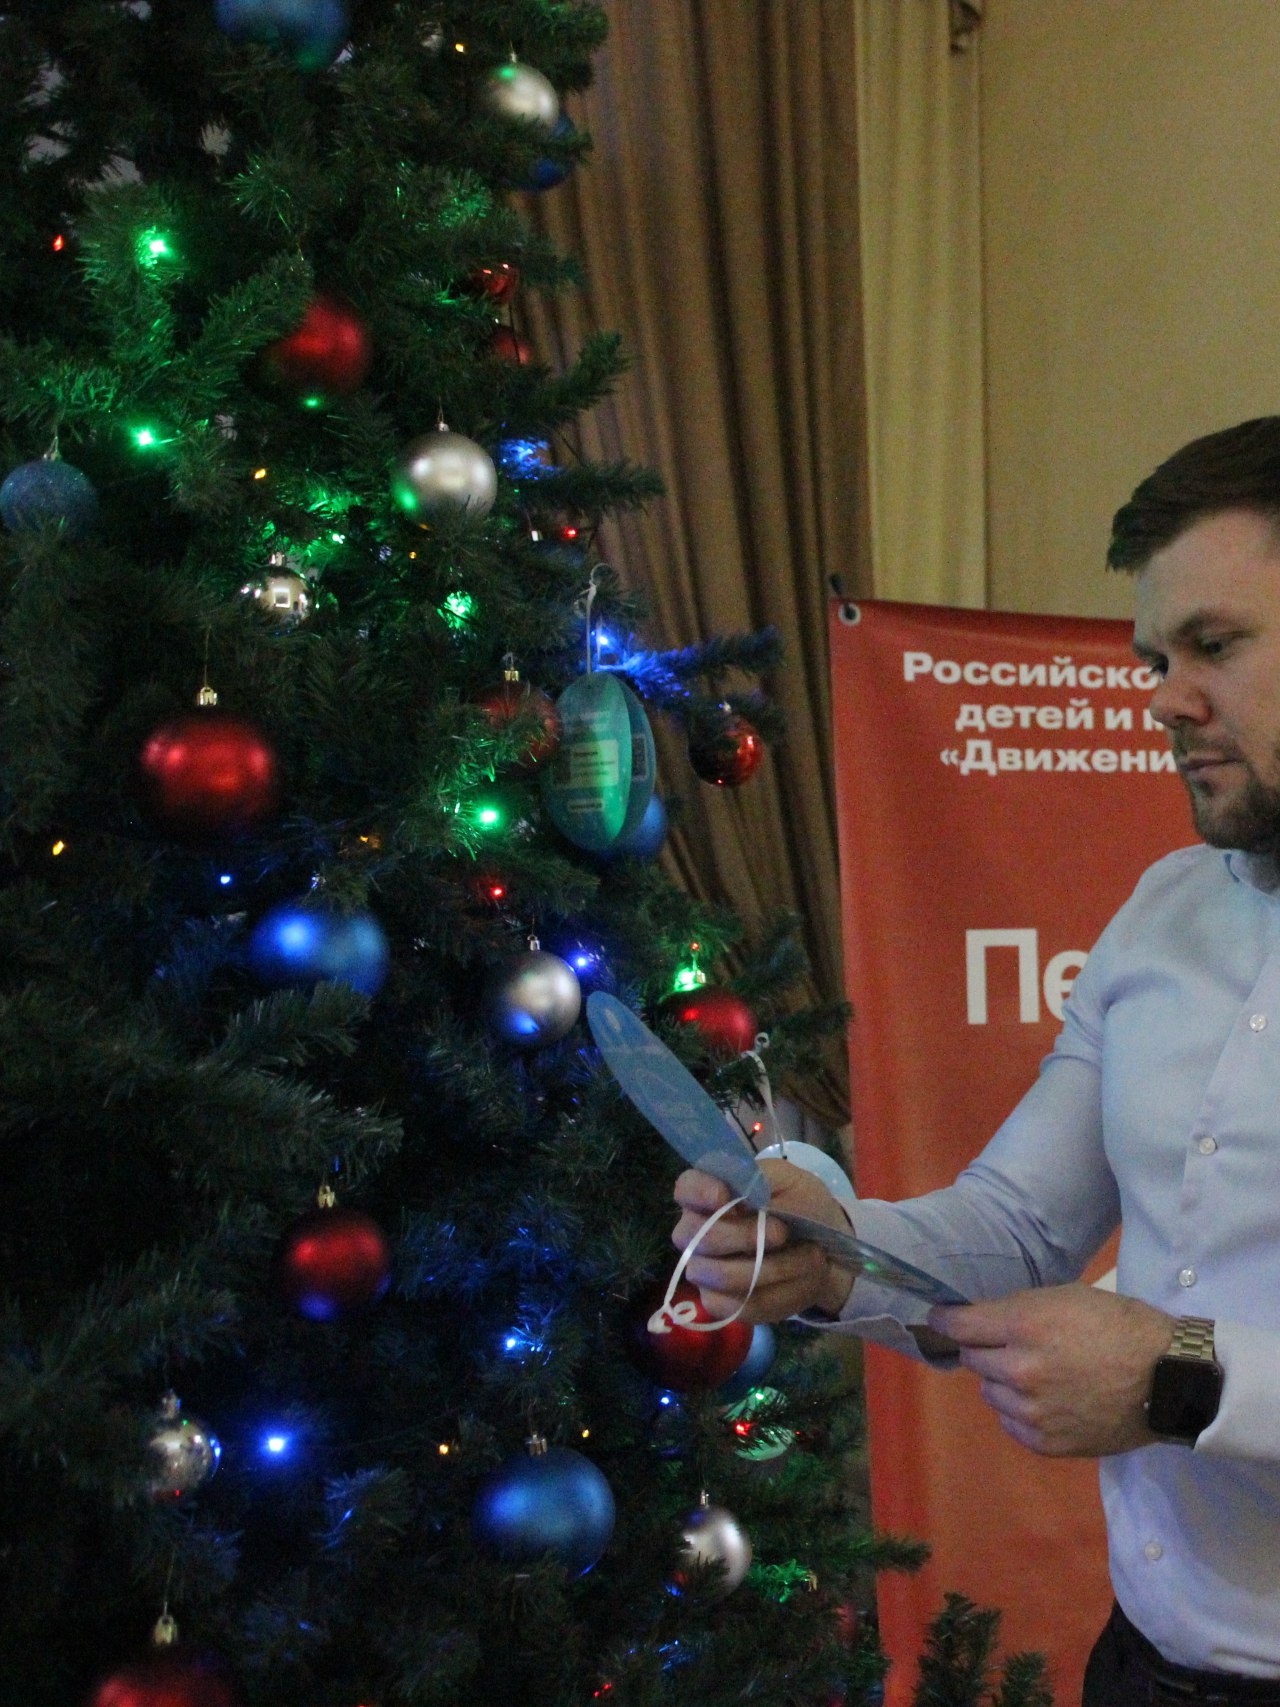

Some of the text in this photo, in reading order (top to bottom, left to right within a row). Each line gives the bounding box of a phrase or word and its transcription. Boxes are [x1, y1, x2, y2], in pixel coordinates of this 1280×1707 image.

[902, 651, 1160, 690] Российско
[954, 698, 1094, 733] детей
[1104, 707, 1133, 732] и
[939, 738, 1178, 777] «Движени
[965, 927, 1091, 1026] Пе
